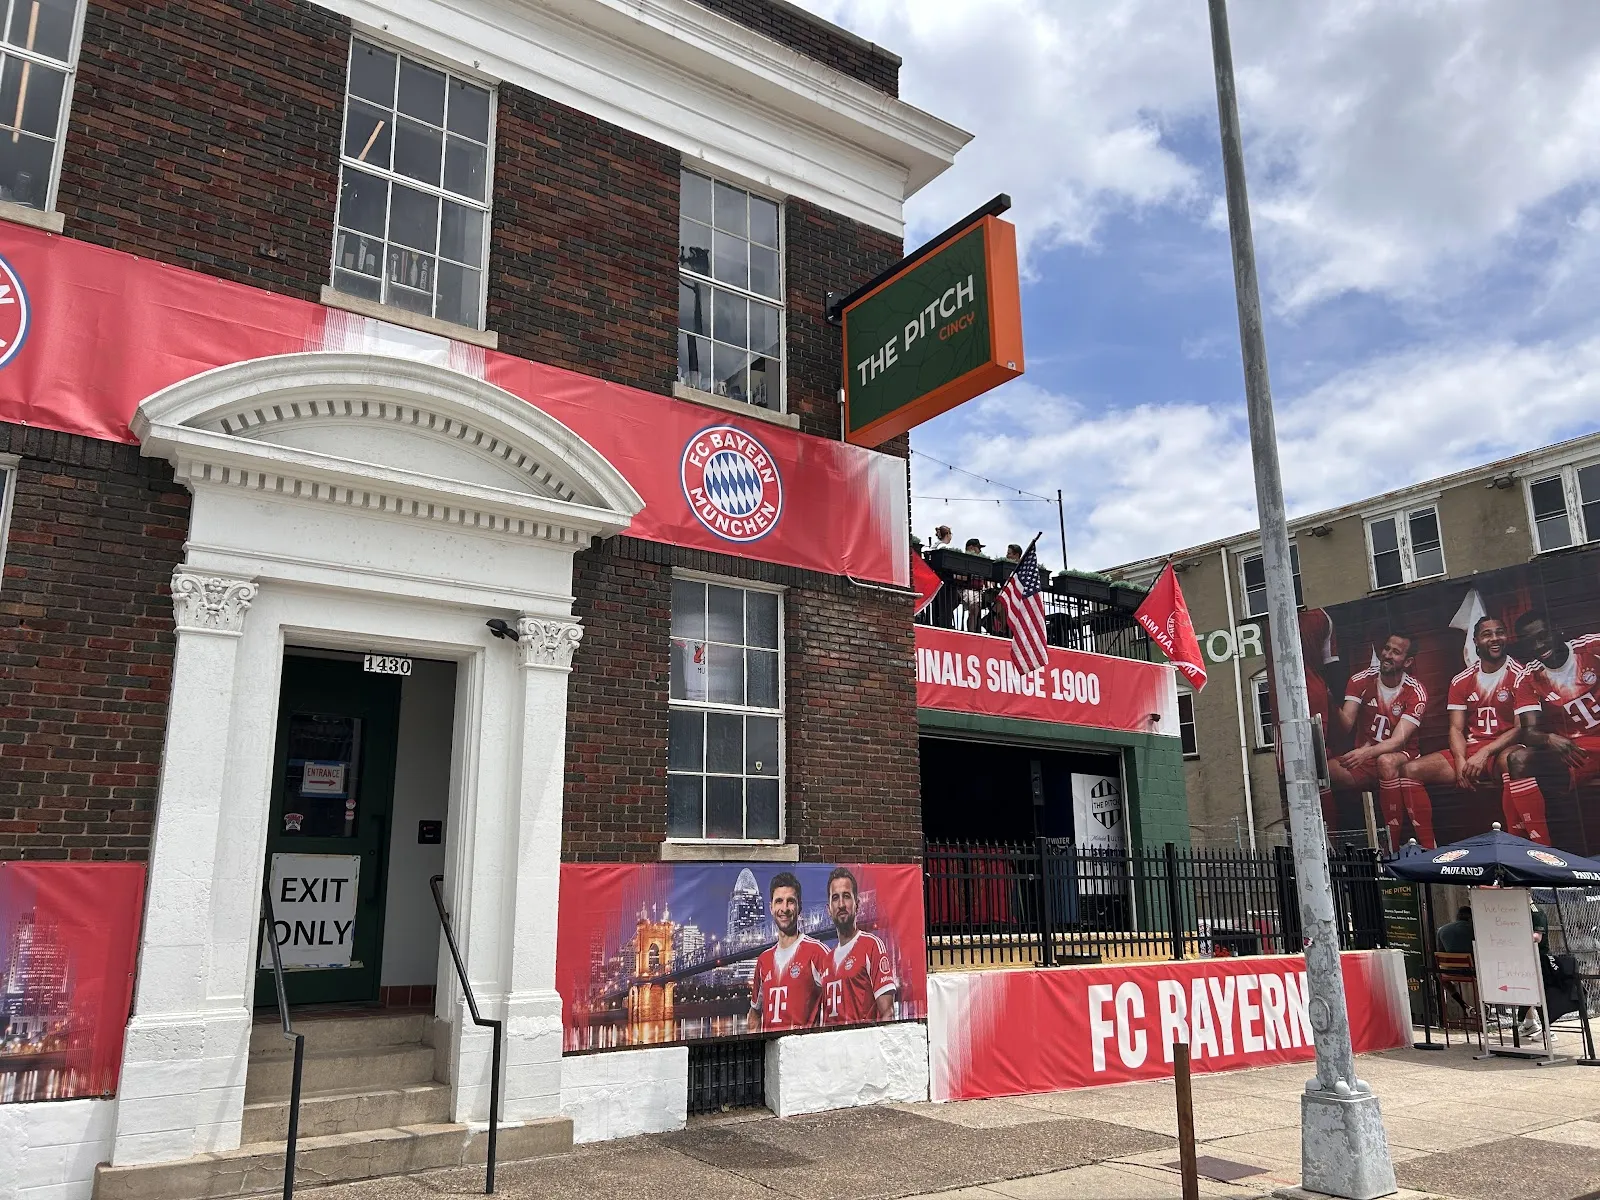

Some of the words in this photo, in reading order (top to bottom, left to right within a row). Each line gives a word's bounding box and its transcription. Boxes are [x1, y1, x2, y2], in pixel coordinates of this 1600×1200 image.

[857, 335, 898, 386] THE
[904, 274, 974, 352] PITCH
[939, 311, 975, 340] CINCY
[689, 441, 710, 468] FC
[710, 432, 775, 483] BAYERN
[365, 656, 411, 674] 1430
[914, 648, 981, 690] INALS
[986, 657, 1046, 699] SINCE
[1050, 667, 1101, 706] 1900
[307, 767, 341, 779] ENTRANCE
[1572, 870, 1600, 880] PAULA
[281, 877, 349, 903] EXIT
[273, 920, 352, 946] ONLY
[1088, 981, 1148, 1072] FC
[1157, 972, 1315, 1063] BAYERN
